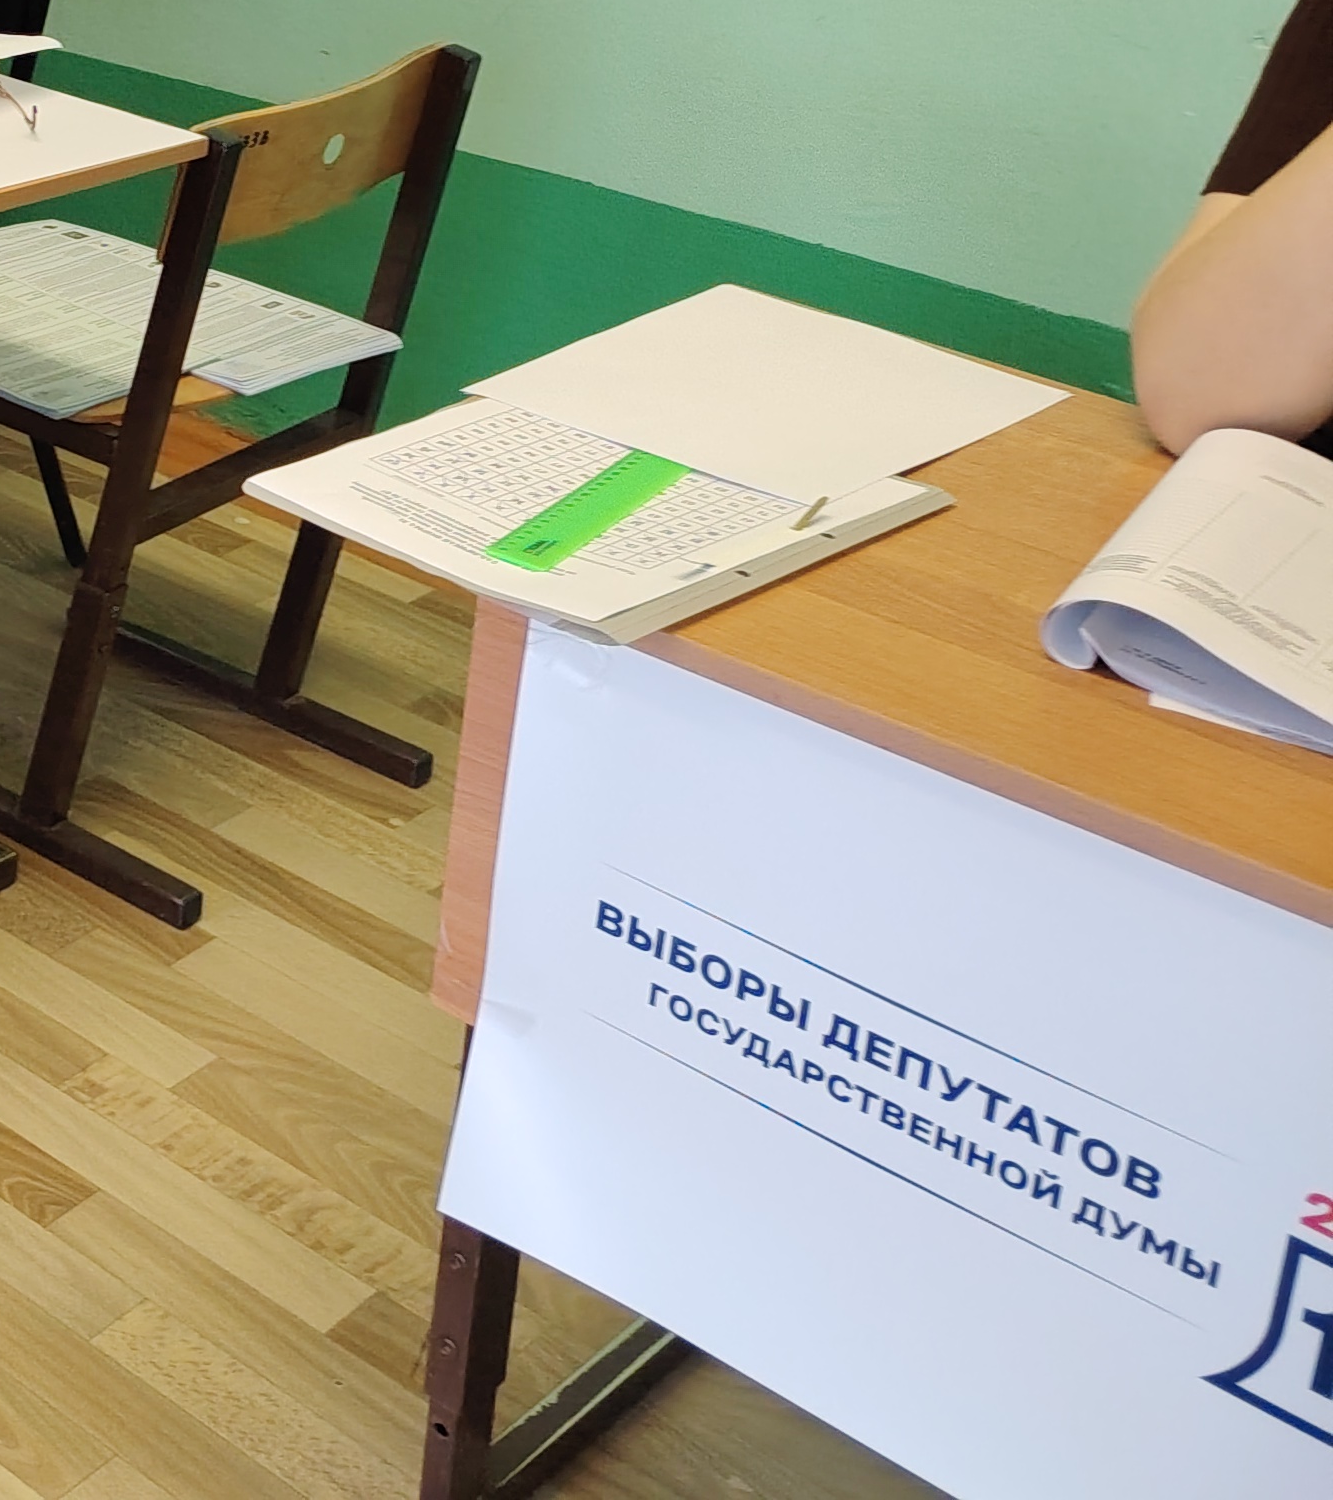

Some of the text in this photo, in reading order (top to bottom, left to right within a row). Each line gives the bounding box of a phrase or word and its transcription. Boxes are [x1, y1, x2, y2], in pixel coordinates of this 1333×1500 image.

[594, 900, 1163, 1200] ВЫБОРЫ ДЕПУТАТОВ
[648, 982, 1221, 1288] ГОСУДАРСТВЕННОЙ ДУМЫ
